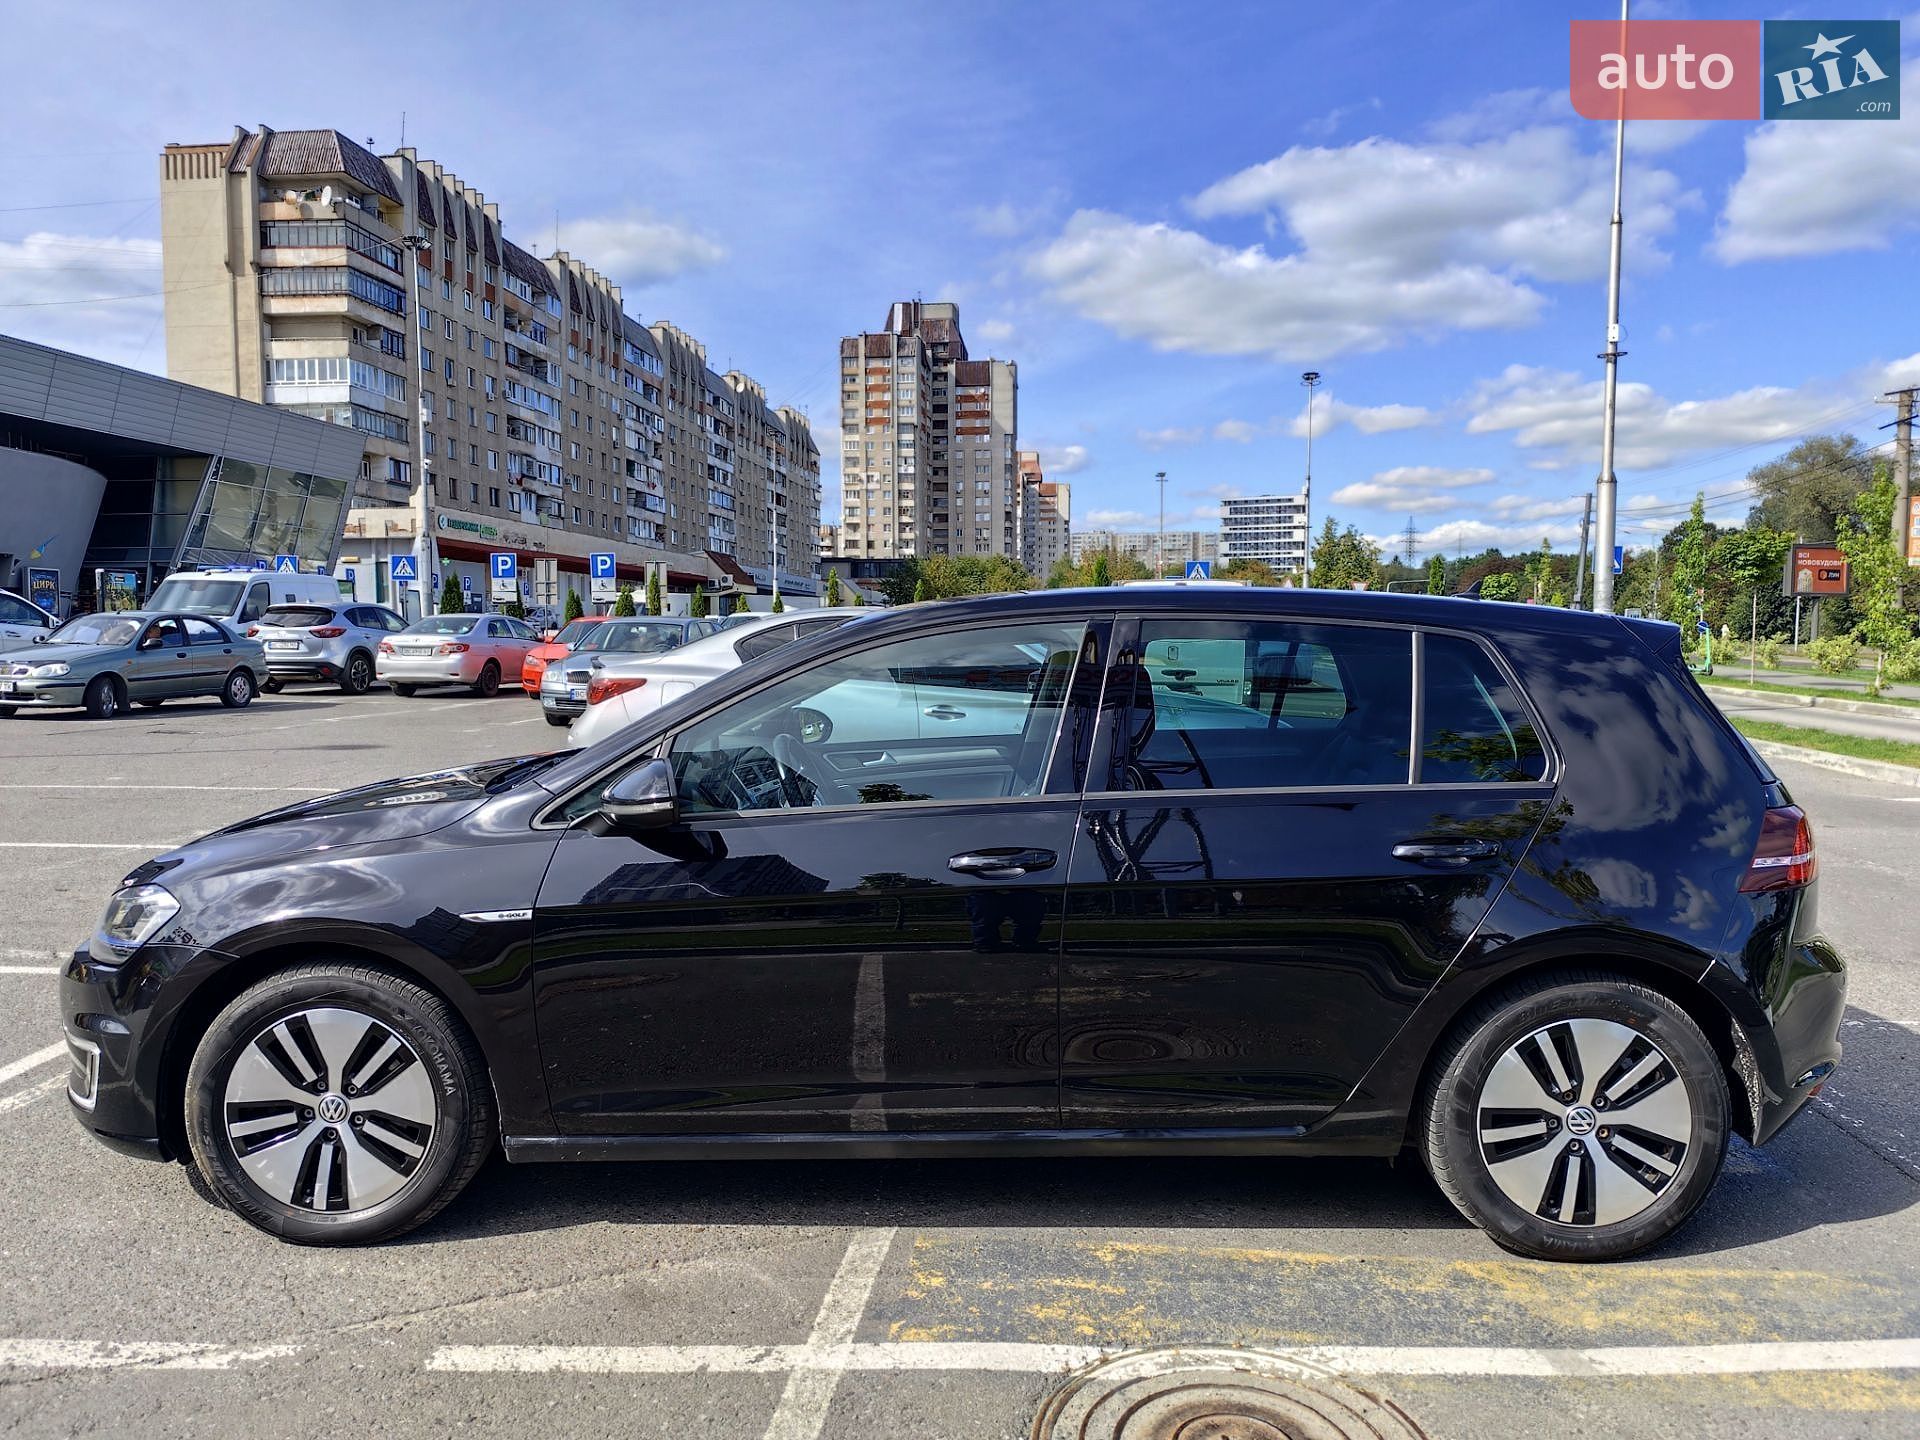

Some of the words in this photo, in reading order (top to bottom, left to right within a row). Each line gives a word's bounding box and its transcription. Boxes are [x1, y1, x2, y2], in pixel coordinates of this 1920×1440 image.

[498, 556, 512, 576] P
[597, 555, 611, 576] P
[33, 580, 55, 590] ЦИРК
